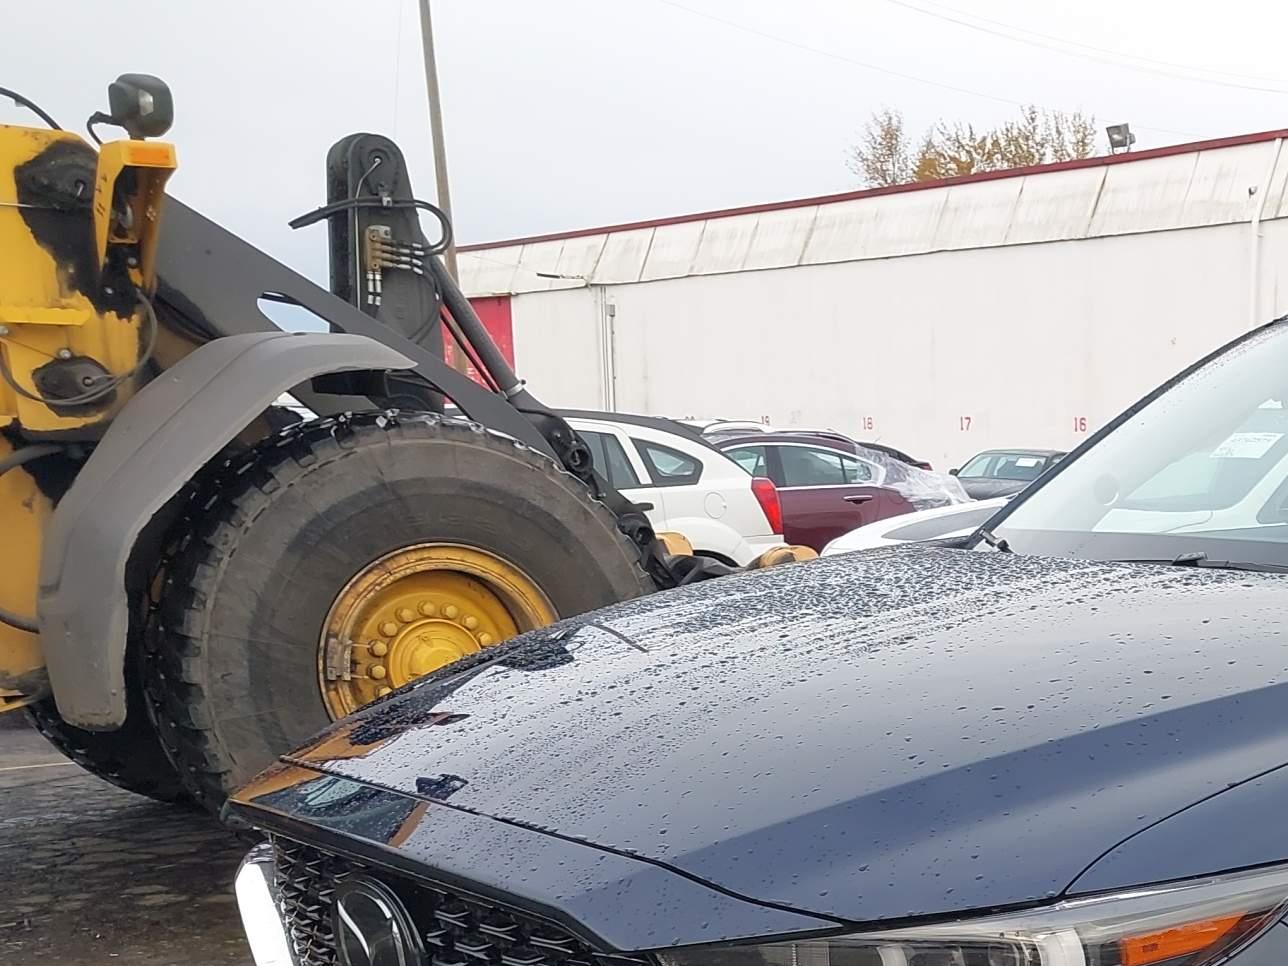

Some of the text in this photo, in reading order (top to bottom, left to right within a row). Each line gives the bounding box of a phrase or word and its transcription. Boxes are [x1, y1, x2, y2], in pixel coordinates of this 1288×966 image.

[863, 416, 874, 430] 18
[960, 416, 971, 431] 17
[1074, 416, 1087, 432] 16
